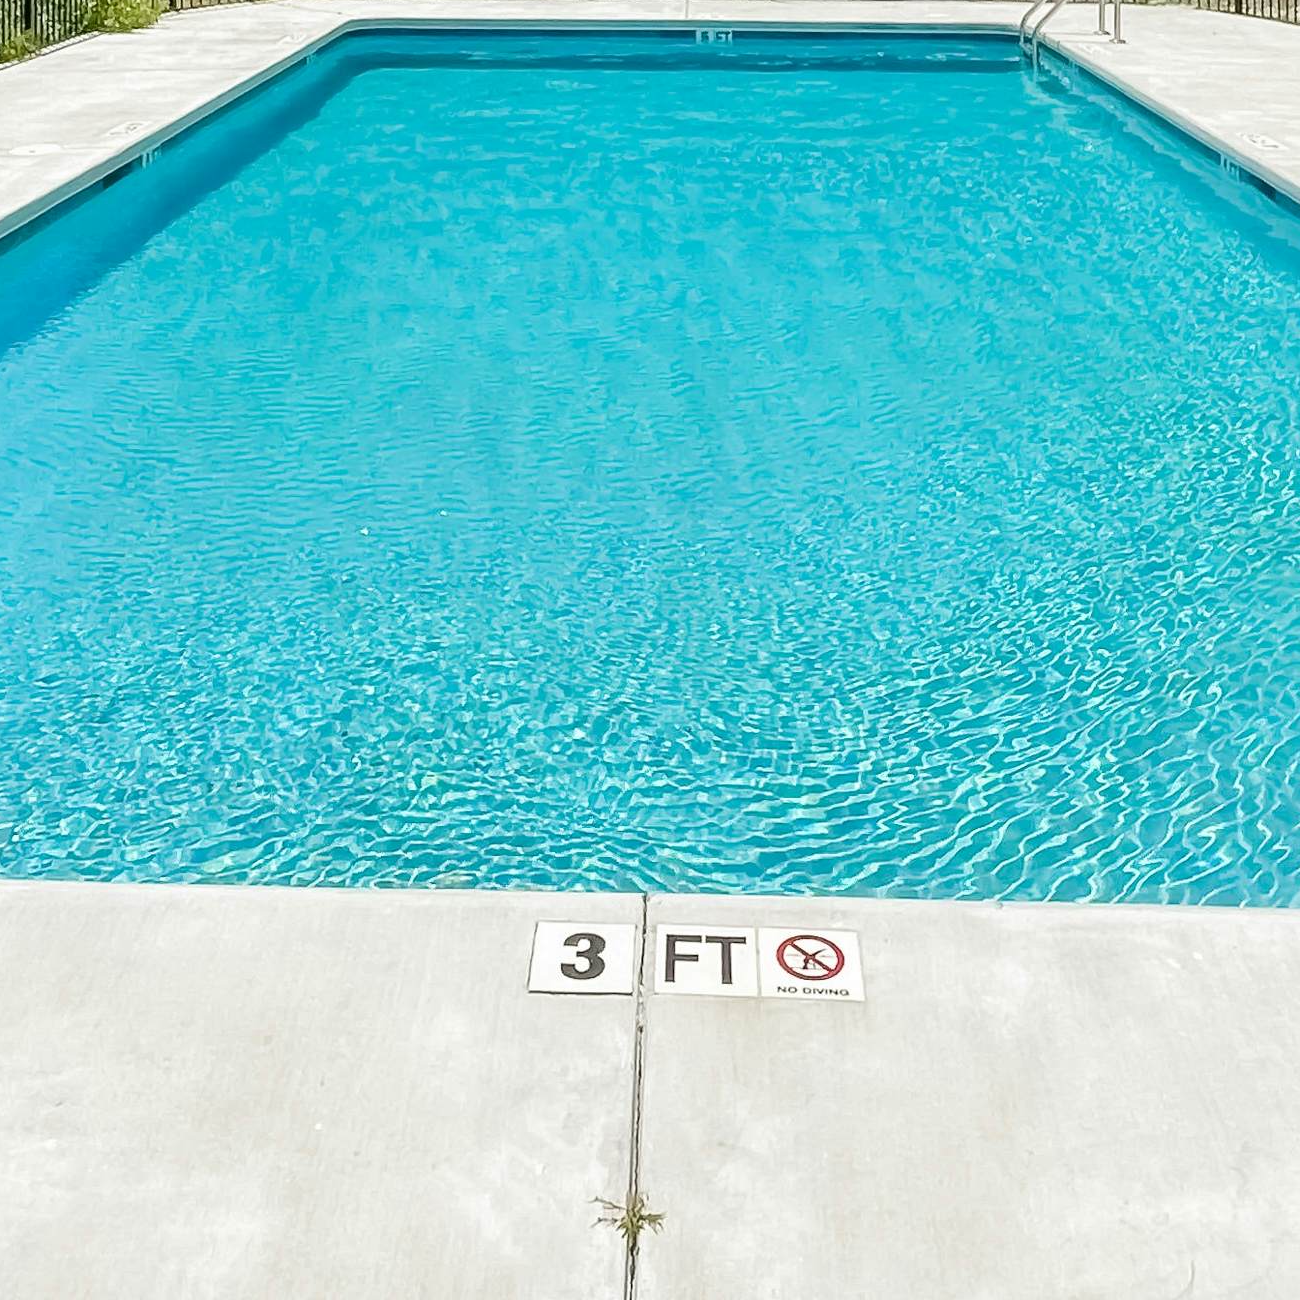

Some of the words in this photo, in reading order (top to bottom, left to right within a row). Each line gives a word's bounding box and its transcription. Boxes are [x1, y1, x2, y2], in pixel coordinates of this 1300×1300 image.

[560, 932, 607, 980] 3
[664, 933, 747, 985] FT
[777, 986, 798, 994] NO
[802, 987, 850, 997] DIVING
